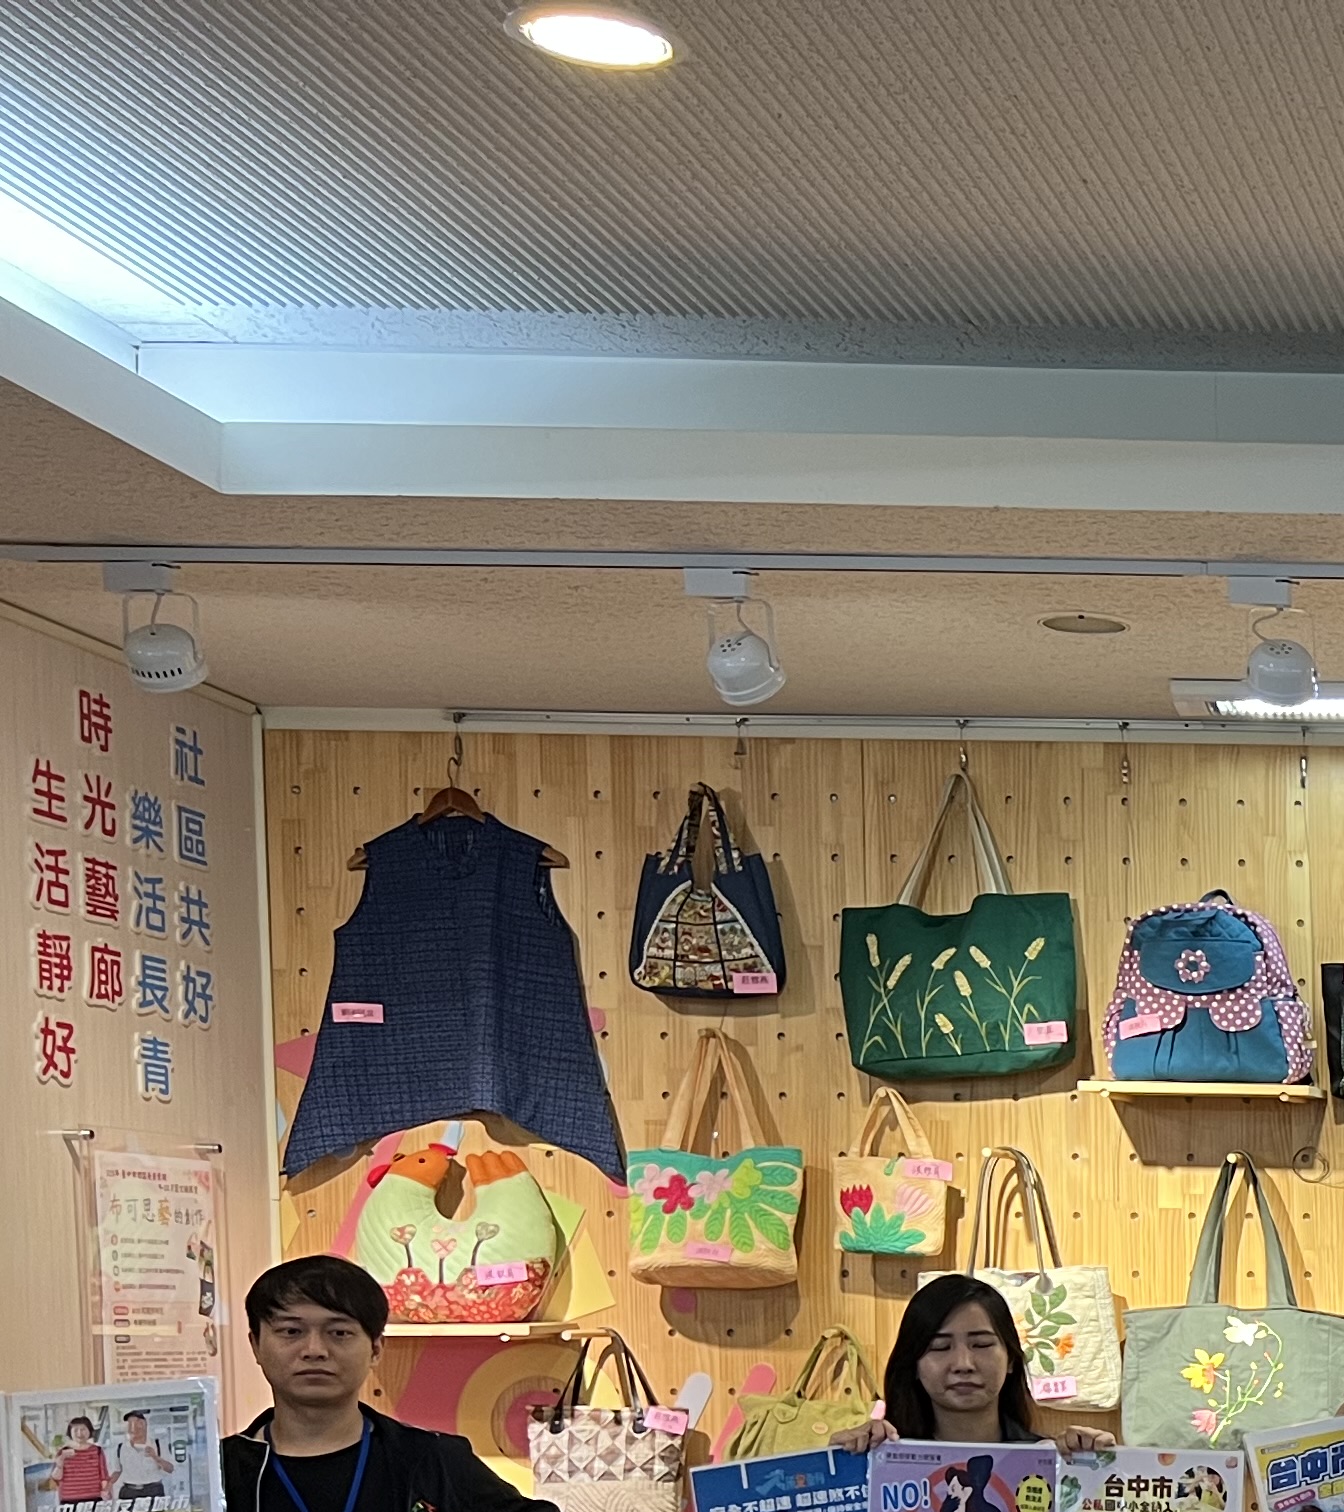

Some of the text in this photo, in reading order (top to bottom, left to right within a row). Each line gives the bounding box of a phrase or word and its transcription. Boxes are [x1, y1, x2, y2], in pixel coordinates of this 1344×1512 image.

[31, 758, 75, 1078] 生活靜好
[79, 690, 123, 1003] 時光藝廊
[131, 790, 172, 1097] 樂活長青
[174, 727, 213, 1024] 社區共好
[883, 1481, 930, 1510] NO!
[1104, 1473, 1173, 1499] 台中市
